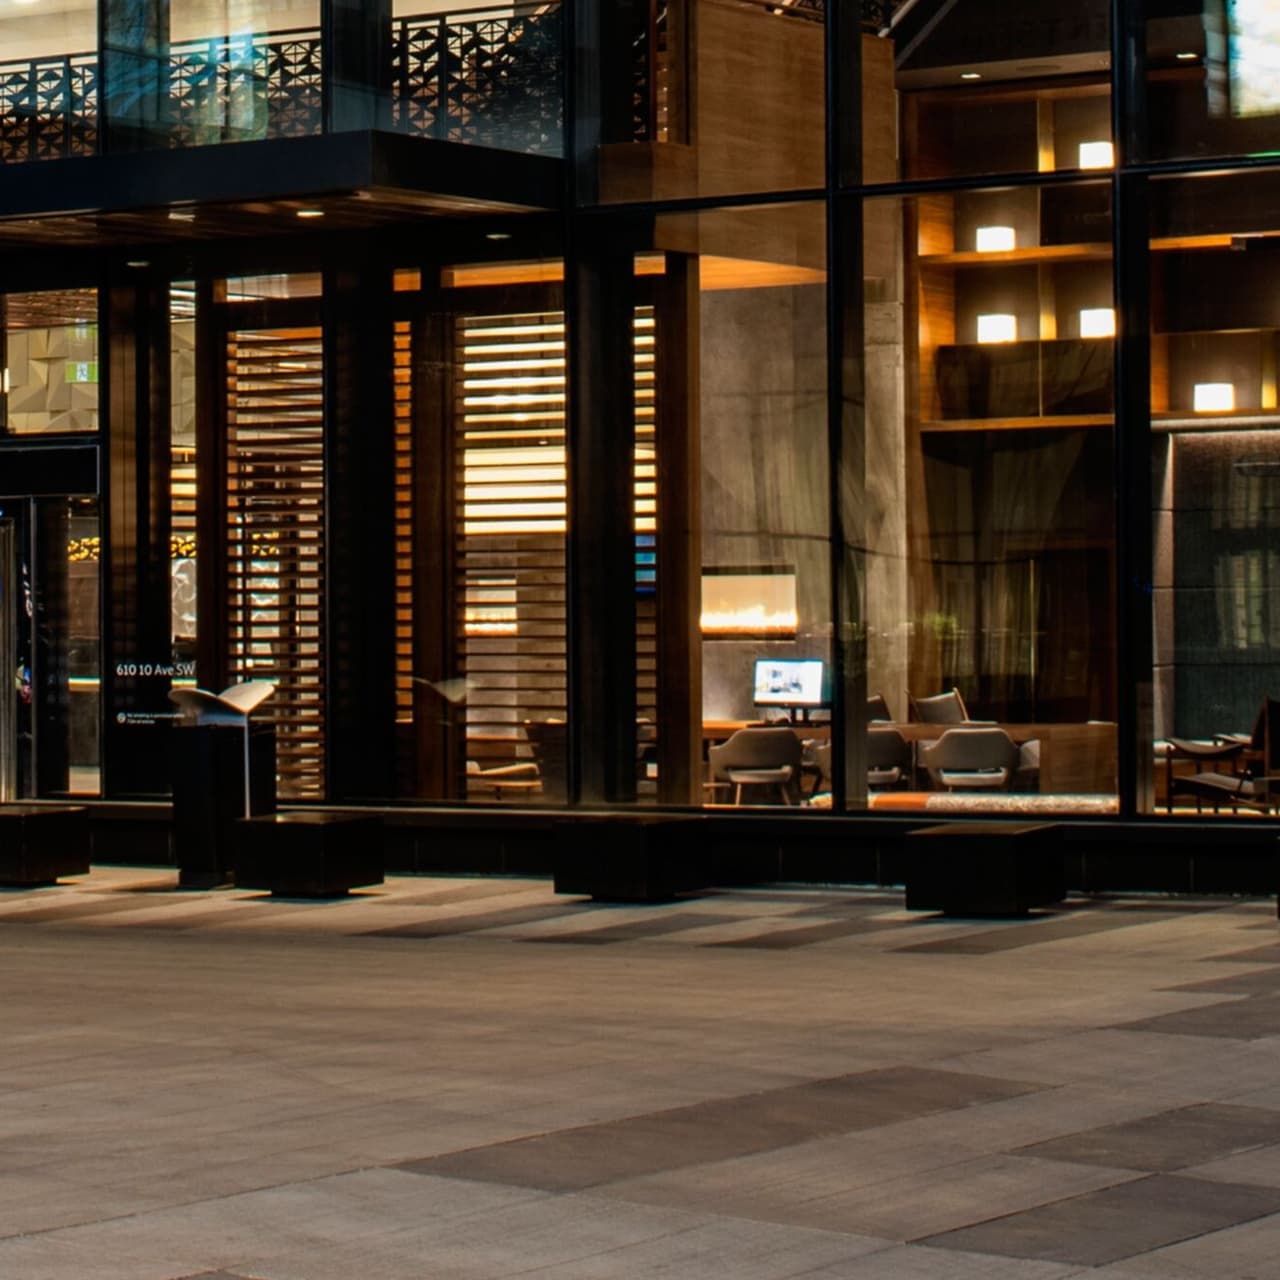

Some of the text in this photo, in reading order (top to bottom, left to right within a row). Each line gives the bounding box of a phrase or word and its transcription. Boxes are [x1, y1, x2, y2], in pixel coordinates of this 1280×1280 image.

[117, 660, 197, 676] 610 10 Ave SW
